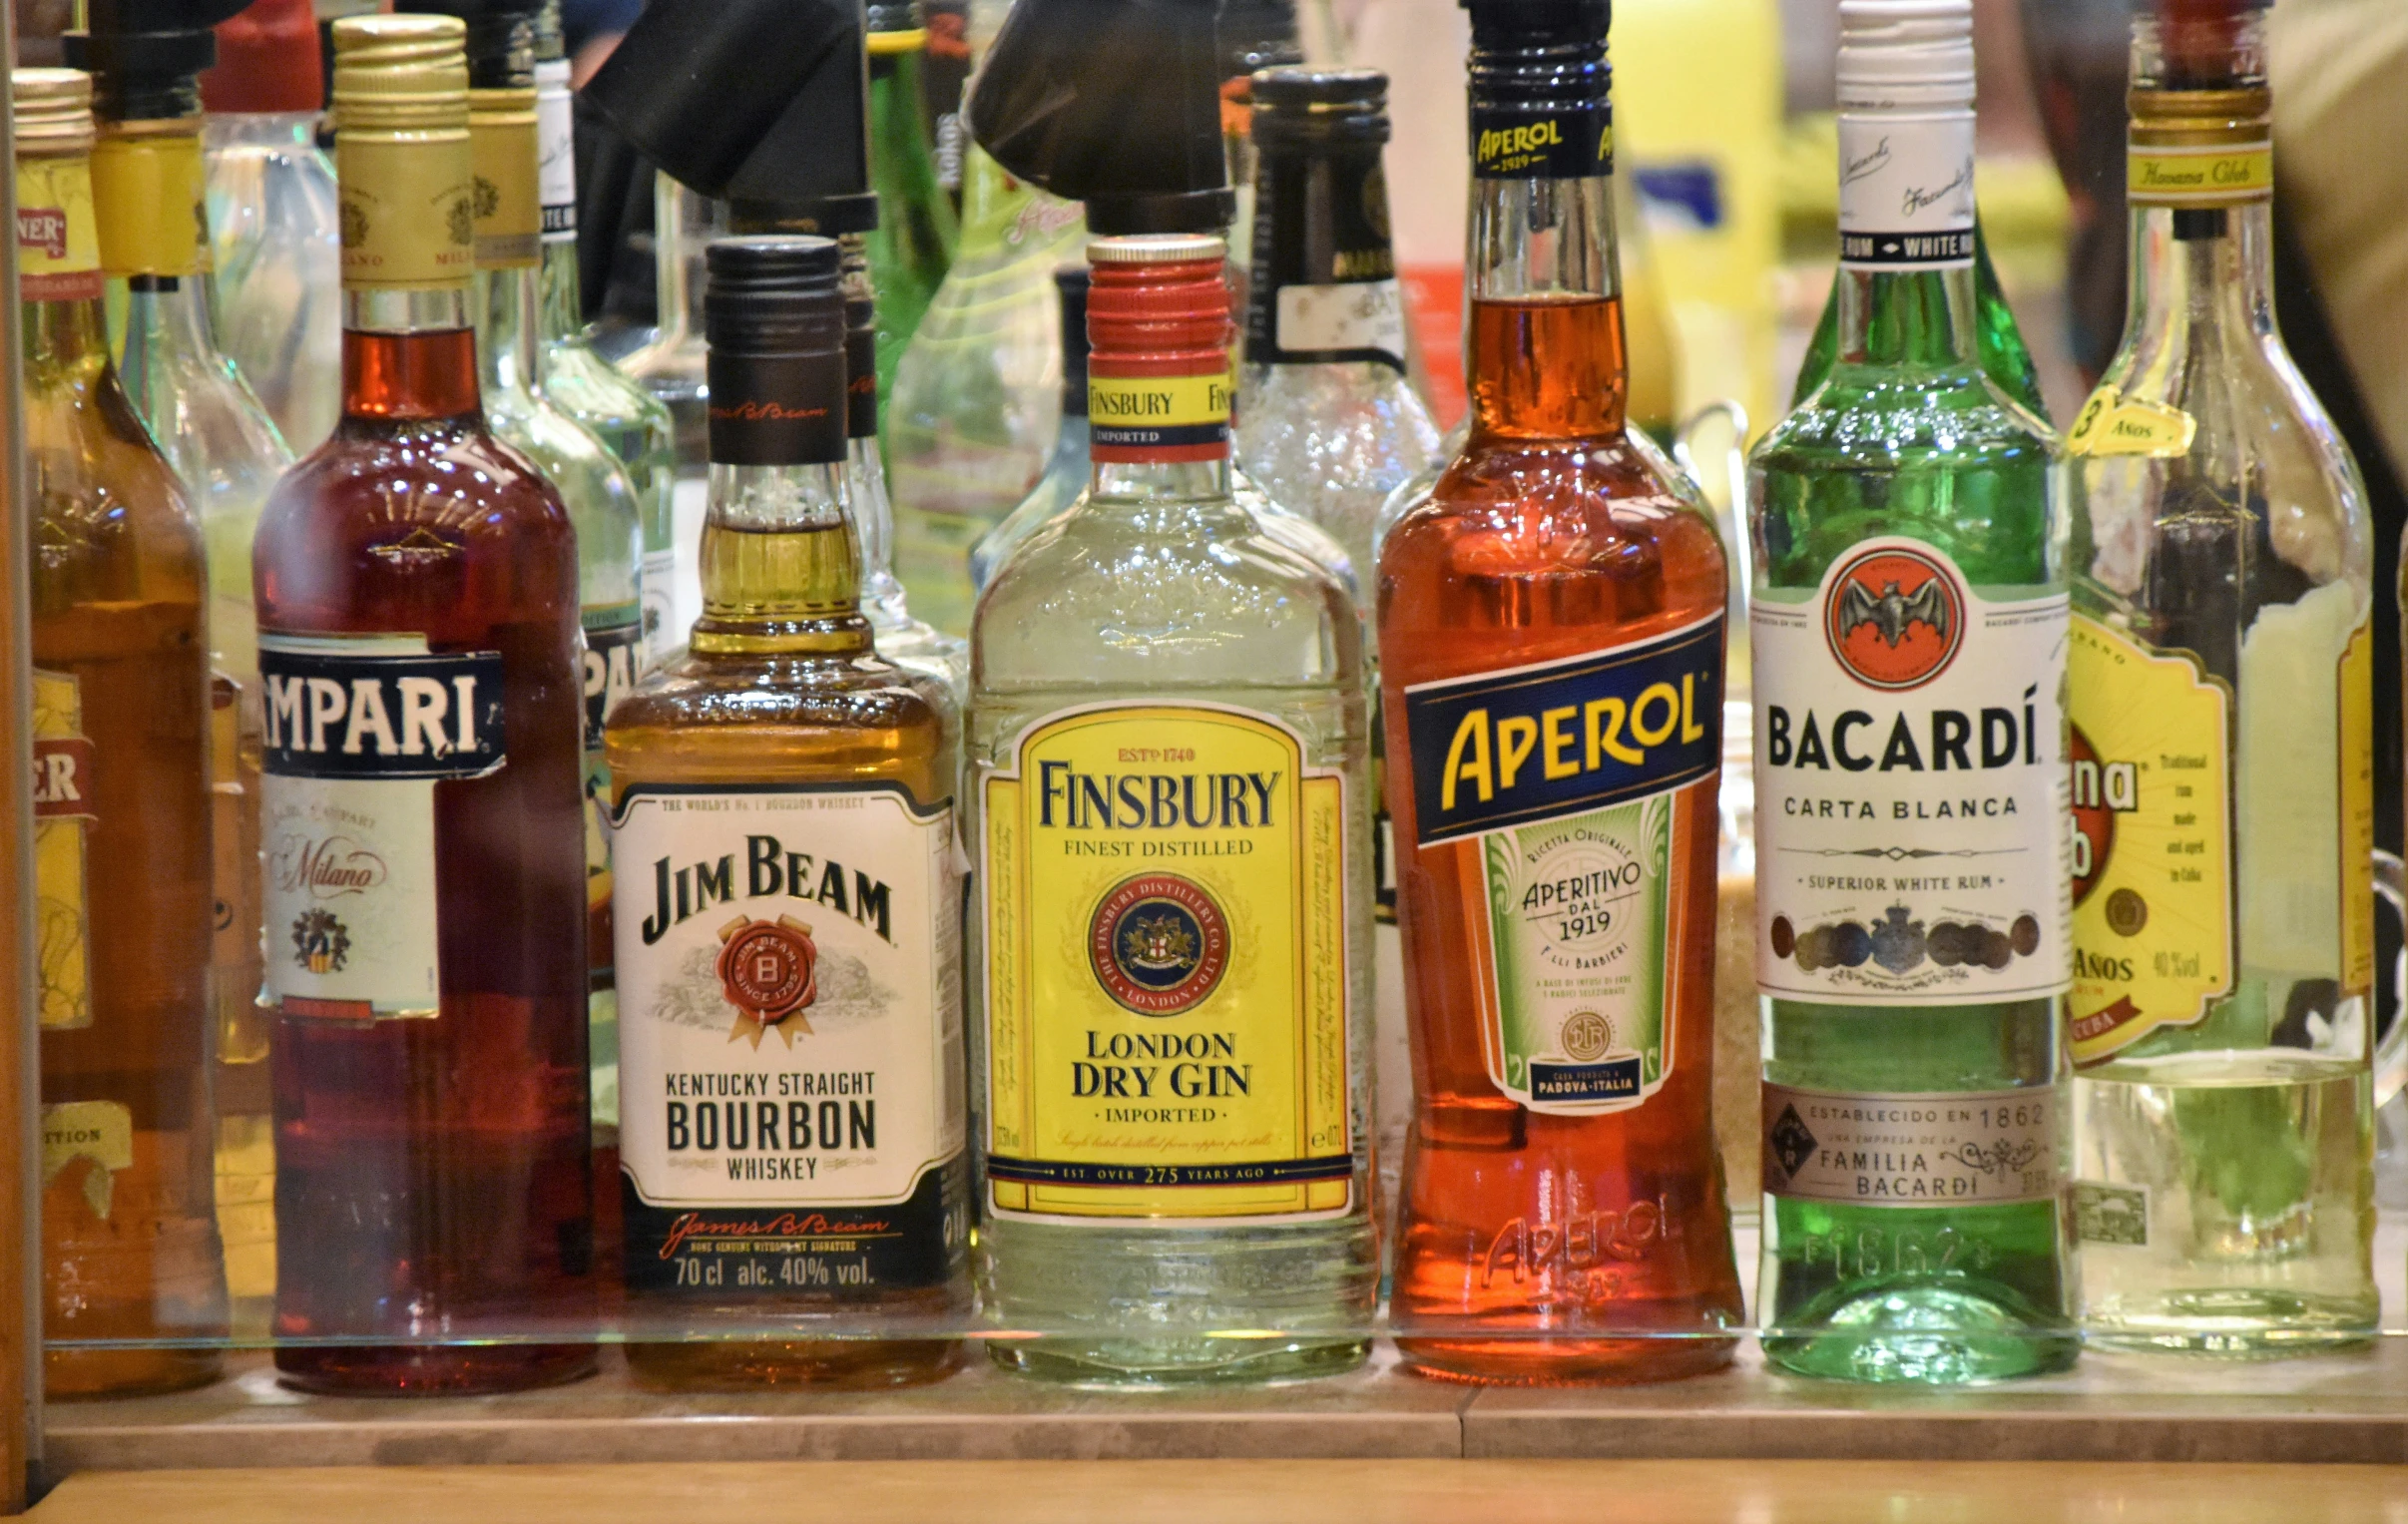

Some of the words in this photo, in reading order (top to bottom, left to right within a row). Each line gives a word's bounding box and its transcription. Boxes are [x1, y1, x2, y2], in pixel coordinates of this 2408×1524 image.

[1478, 120, 1563, 163] APEROL
[1847, 238, 1874, 256] RUM
[1904, 236, 1958, 257] WHITE
[1090, 385, 1174, 416] FINSBURY
[2076, 400, 2101, 439] 3
[1097, 430, 1160, 442] IMPORTED
[1768, 682, 2038, 772] BACARDÍ
[1164, 748, 1196, 762] 1740
[1441, 673, 1704, 811] APEROL
[663, 799, 683, 811] THE
[765, 798, 812, 811] BOURBON
[818, 797, 865, 809] WHISKEY
[1038, 759, 1283, 829] FINSBURY
[1784, 796, 1876, 819] CARTA
[1893, 795, 2018, 819] BLANCA
[1064, 839, 1136, 856] FINEST
[1142, 838, 1253, 856] DISTILLED
[1528, 833, 1570, 863] RICETTA
[1575, 828, 1632, 860] ORIGINALE
[281, 835, 388, 898] Milano
[642, 853, 737, 946] JIM
[745, 834, 893, 945] BEAM
[1522, 861, 1642, 910] APERITIVO
[1808, 875, 1887, 891] SUPERIOR
[1894, 876, 1950, 890] WHITE
[1957, 876, 1992, 889] RUM
[1139, 882, 1213, 923] DISTILLERY
[1570, 901, 1601, 916] DAL
[1098, 889, 1135, 950] FINSBURY
[1560, 910, 1611, 941] 1919
[738, 941, 755, 962] JIM
[760, 937, 796, 963] BEAM
[1576, 942, 1629, 969] BARBIERI
[757, 956, 778, 982] B
[1099, 955, 1120, 985] THE
[1199, 957, 1218, 985] LTD
[737, 973, 770, 1002] SINCE
[775, 974, 798, 999] 1795
[1127, 989, 1191, 1007] LONDON
[1086, 1030, 1237, 1059] LONDON
[666, 1073, 768, 1097] KENTUCKY
[779, 1072, 875, 1096] STRAIGHT
[1071, 1062, 1158, 1098] DRY
[1169, 1062, 1252, 1098] GIN
[667, 1100, 876, 1151] BOURBON
[1106, 1108, 1216, 1123] IMPORTED
[1809, 1106, 1938, 1124] ESTABLECIDO
[1947, 1110, 1971, 1123] EN
[1979, 1103, 2044, 1130] 1862
[1856, 1135, 1914, 1145] EMPRESA
[1921, 1136, 1936, 1145] DE
[727, 1157, 817, 1180] WHISKEY
[1820, 1150, 1928, 1173] FAMILIA
[1098, 1169, 1135, 1181] OVER
[1145, 1167, 1179, 1185] 275
[1188, 1169, 1229, 1181] YEARS
[1235, 1168, 1264, 1179] AGO
[659, 1212, 758, 1261] James
[810, 1241, 856, 1252] SIGNATURE
[674, 1258, 701, 1285] 70
[706, 1258, 723, 1285] cl
[737, 1258, 774, 1285] alc.
[780, 1257, 829, 1285] 40%
[836, 1257, 875, 1284] vol.
